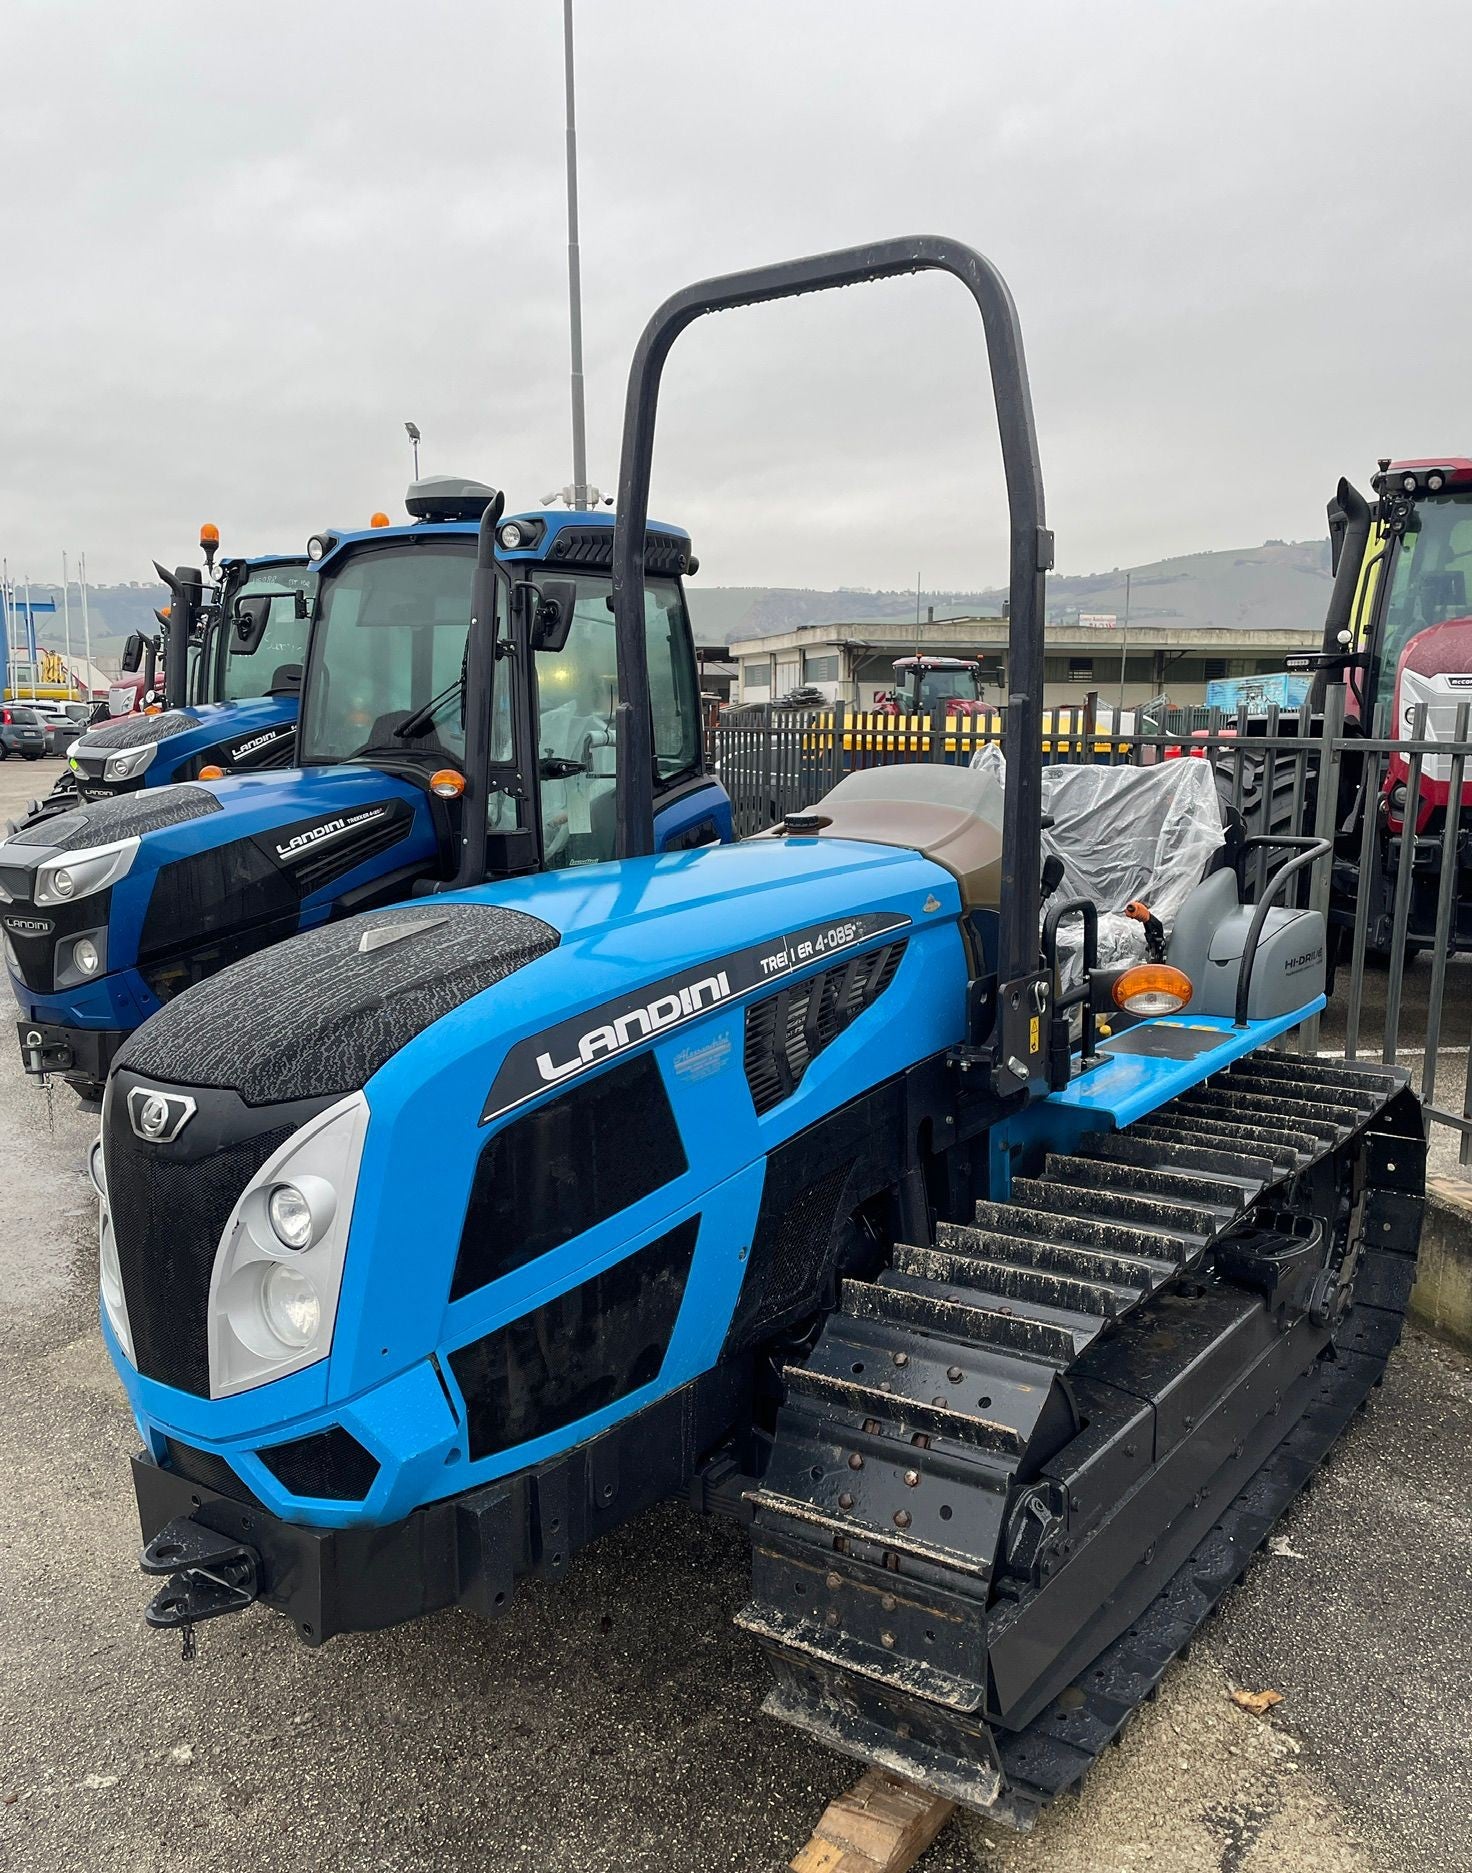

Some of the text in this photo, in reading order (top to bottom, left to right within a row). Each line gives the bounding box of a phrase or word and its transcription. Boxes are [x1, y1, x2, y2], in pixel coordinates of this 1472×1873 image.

[231, 731, 277, 756] LANDINI
[276, 819, 346, 854] LANDINI
[7, 918, 49, 930] LANDINI
[536, 970, 731, 1081] LANDINI
